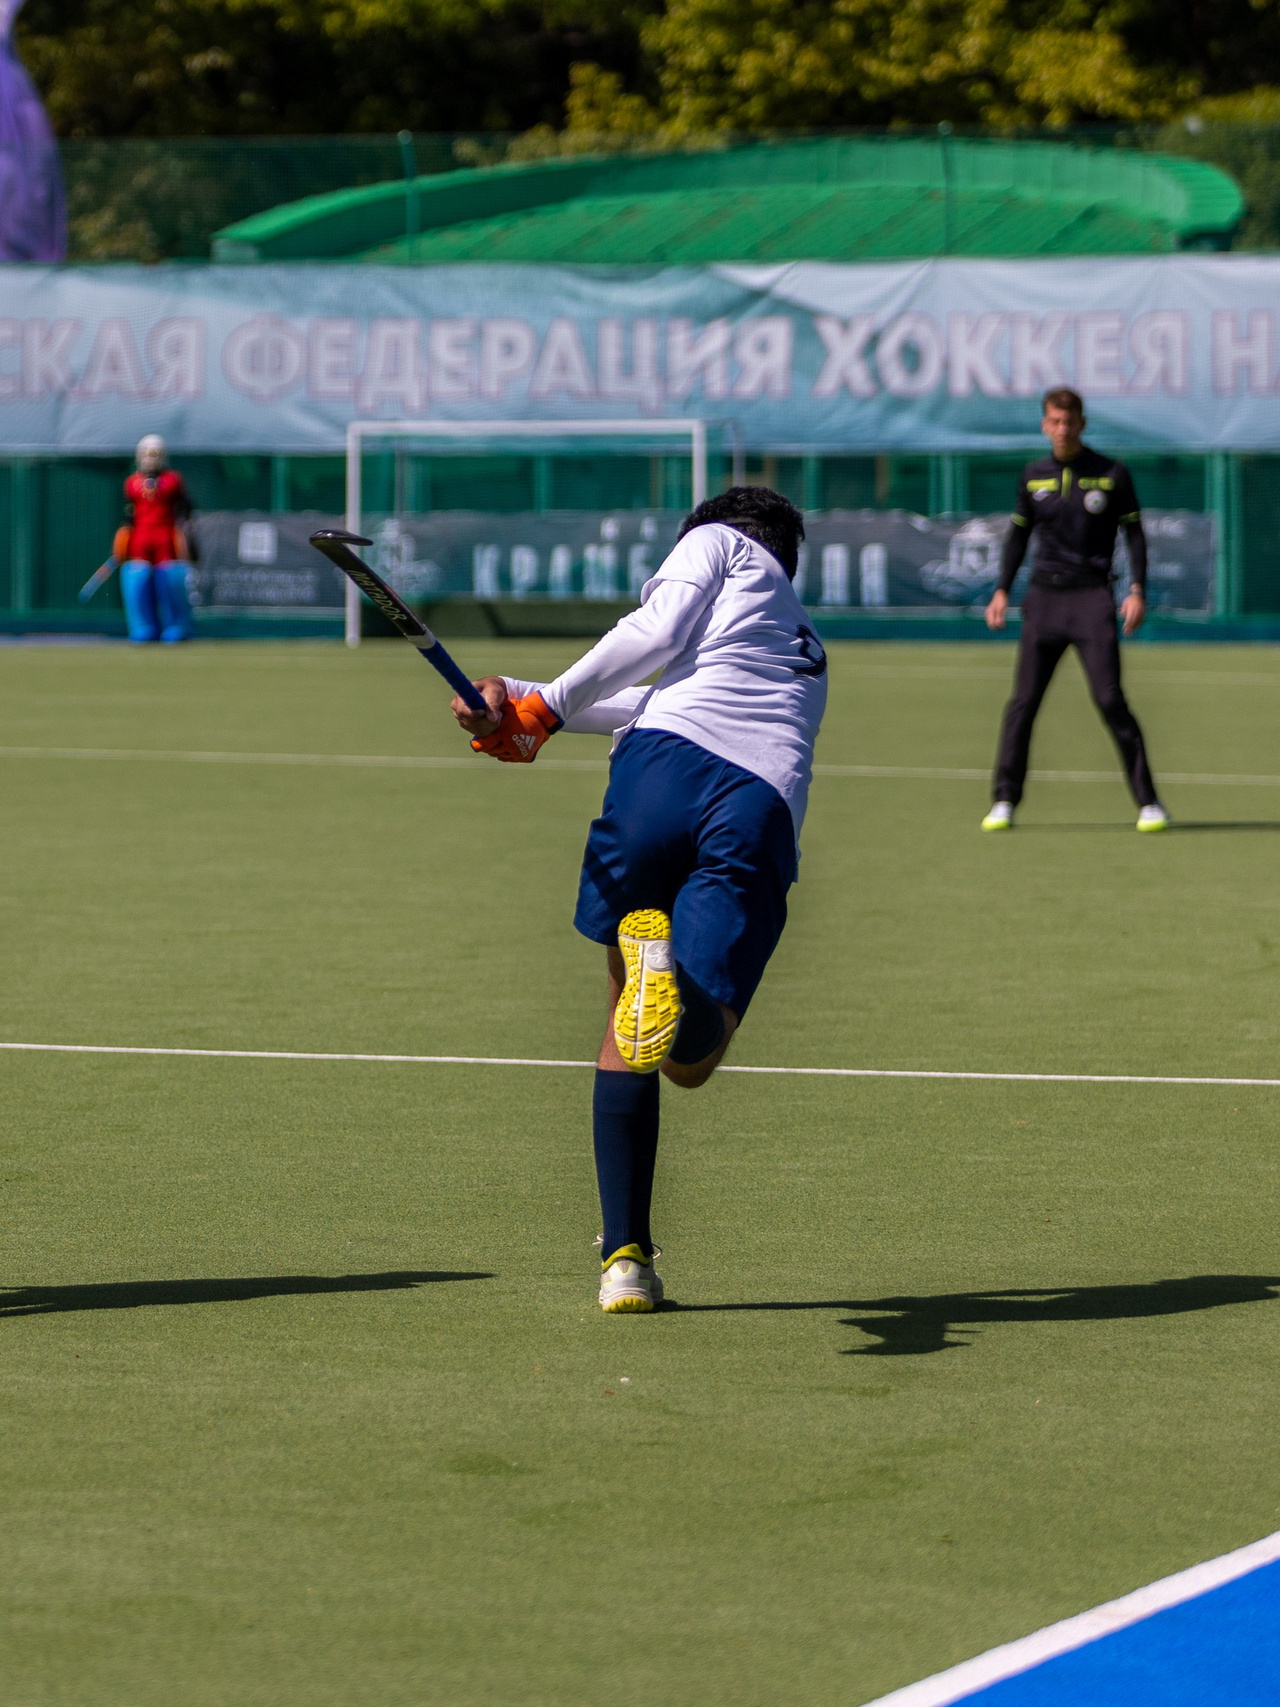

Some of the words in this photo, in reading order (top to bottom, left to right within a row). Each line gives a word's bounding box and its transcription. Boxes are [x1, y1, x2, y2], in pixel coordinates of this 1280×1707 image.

[223, 313, 795, 415] ФЕДЕРАЦИЯ
[813, 312, 1190, 398] ХОККЕЯ
[1211, 307, 1280, 398] Н
[346, 568, 408, 621] MATADOR
